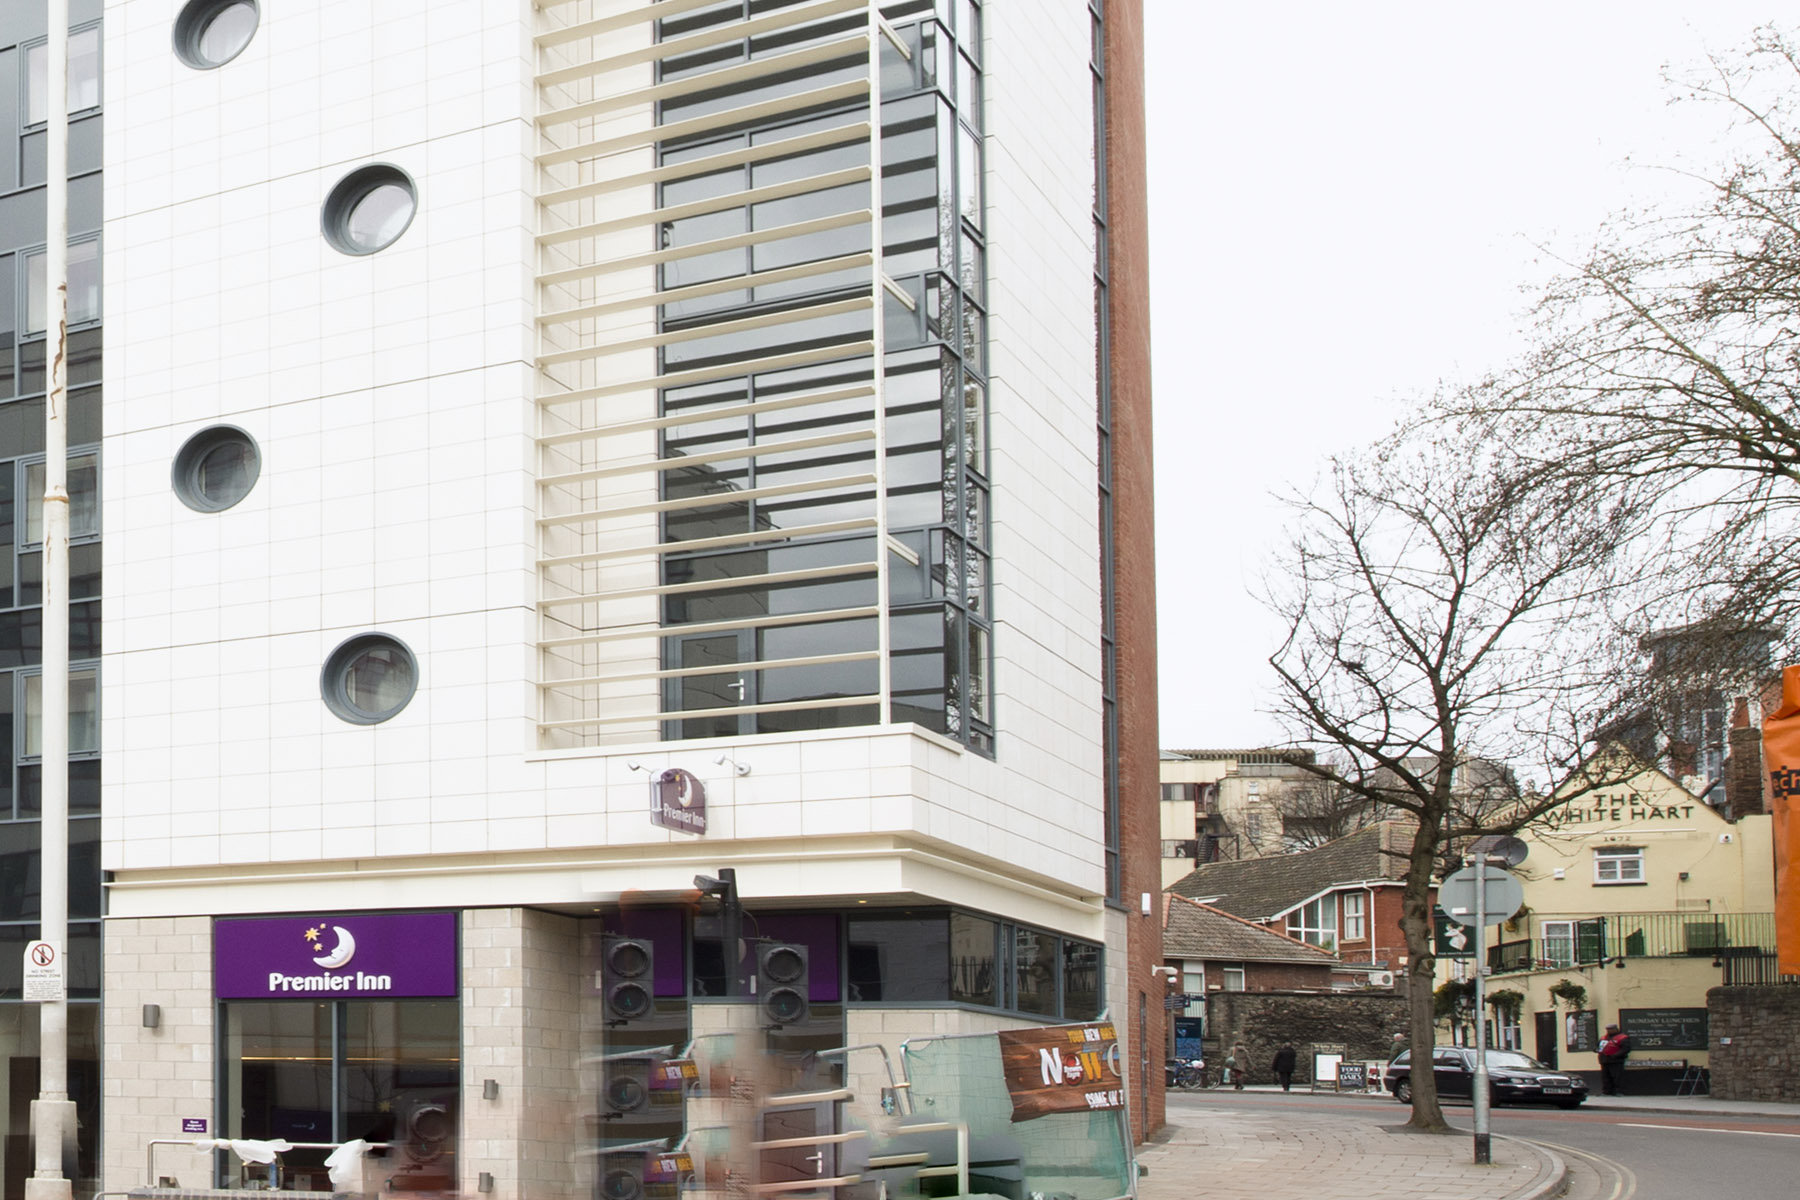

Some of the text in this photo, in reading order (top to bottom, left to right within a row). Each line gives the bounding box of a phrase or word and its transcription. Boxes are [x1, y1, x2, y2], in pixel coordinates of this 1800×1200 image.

[1594, 794, 1640, 806] THE
[663, 803, 691, 824] Premier
[1543, 806, 1694, 823] WHITE HART
[269, 971, 391, 991] Premier Inn
